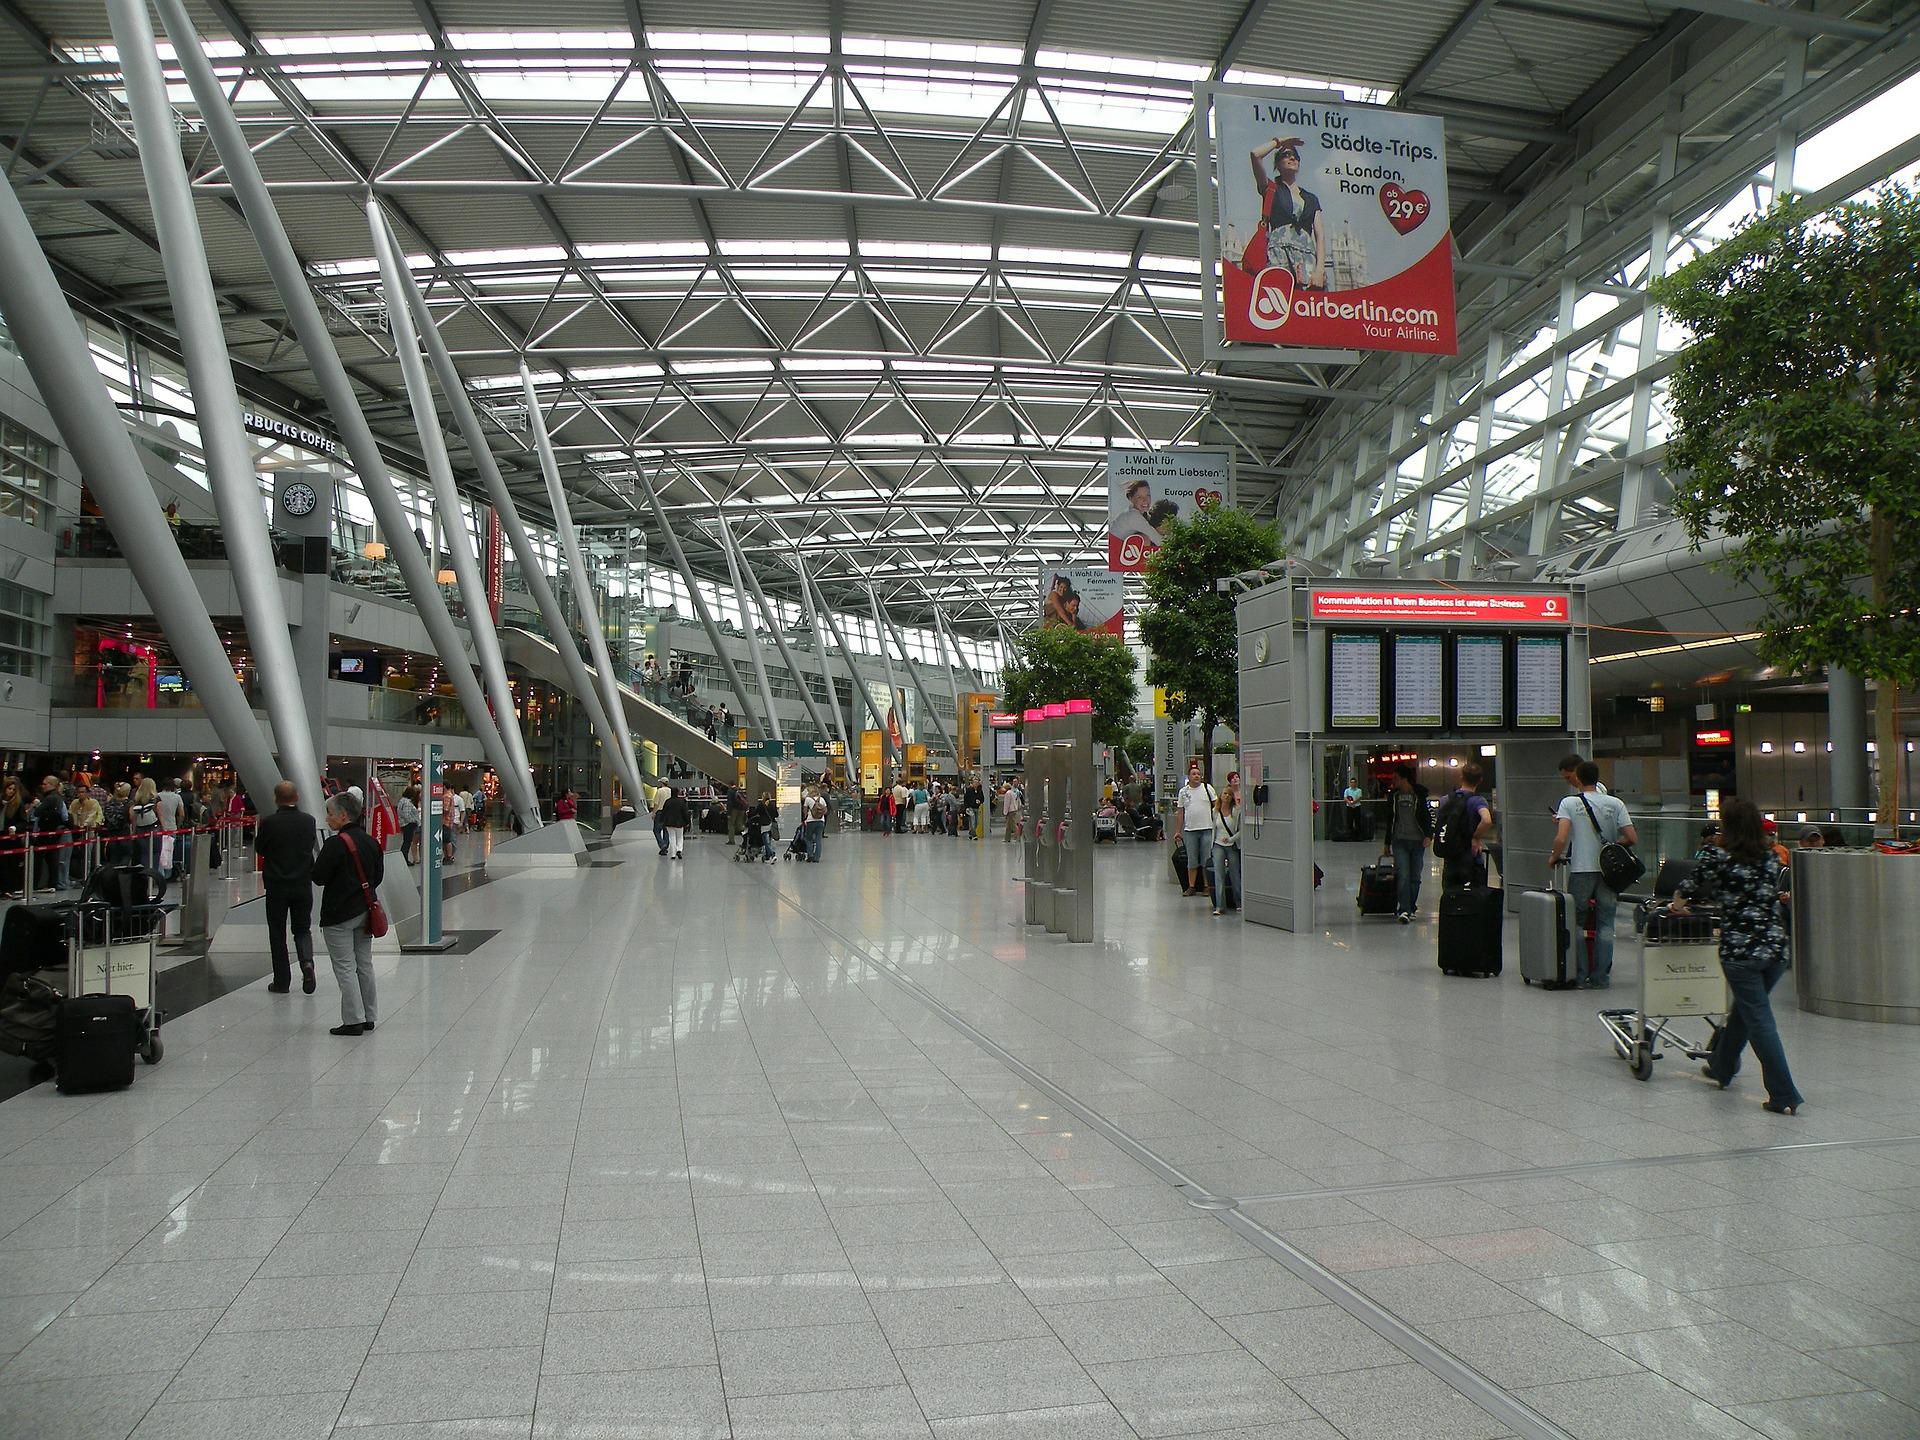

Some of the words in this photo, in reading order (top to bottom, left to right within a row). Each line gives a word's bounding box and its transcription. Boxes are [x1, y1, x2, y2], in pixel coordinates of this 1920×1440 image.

[1253, 104, 1266, 122] 1.
[1268, 106, 1318, 127] Wahl
[1325, 111, 1349, 130] für
[1345, 163, 1405, 183] London,
[1340, 180, 1375, 196] Rom
[1386, 189, 1398, 198] ab
[1294, 296, 1438, 326] airberlin.com
[1363, 323, 1392, 338] Your
[1396, 326, 1440, 342] Airline.
[300, 430, 336, 454] COFFEE
[1125, 455, 1132, 464] 1.
[1133, 455, 1158, 465] Wahl
[1161, 456, 1175, 465] für
[1156, 467, 1177, 476] zum
[1164, 488, 1193, 498] Europa
[1318, 596, 1383, 606] Kommunikation
[1393, 597, 1417, 607] Ihrem
[1418, 598, 1454, 607] Business
[1455, 599, 1465, 607] ist
[1466, 599, 1489, 608] unser
[1489, 599, 1526, 609] Business.
[758, 741, 764, 749] B
[1165, 721, 1174, 771] Information
[1439, 824, 1448, 843] FILA
[117, 962, 134, 972] hier.
[1688, 963, 1707, 973] hier.
